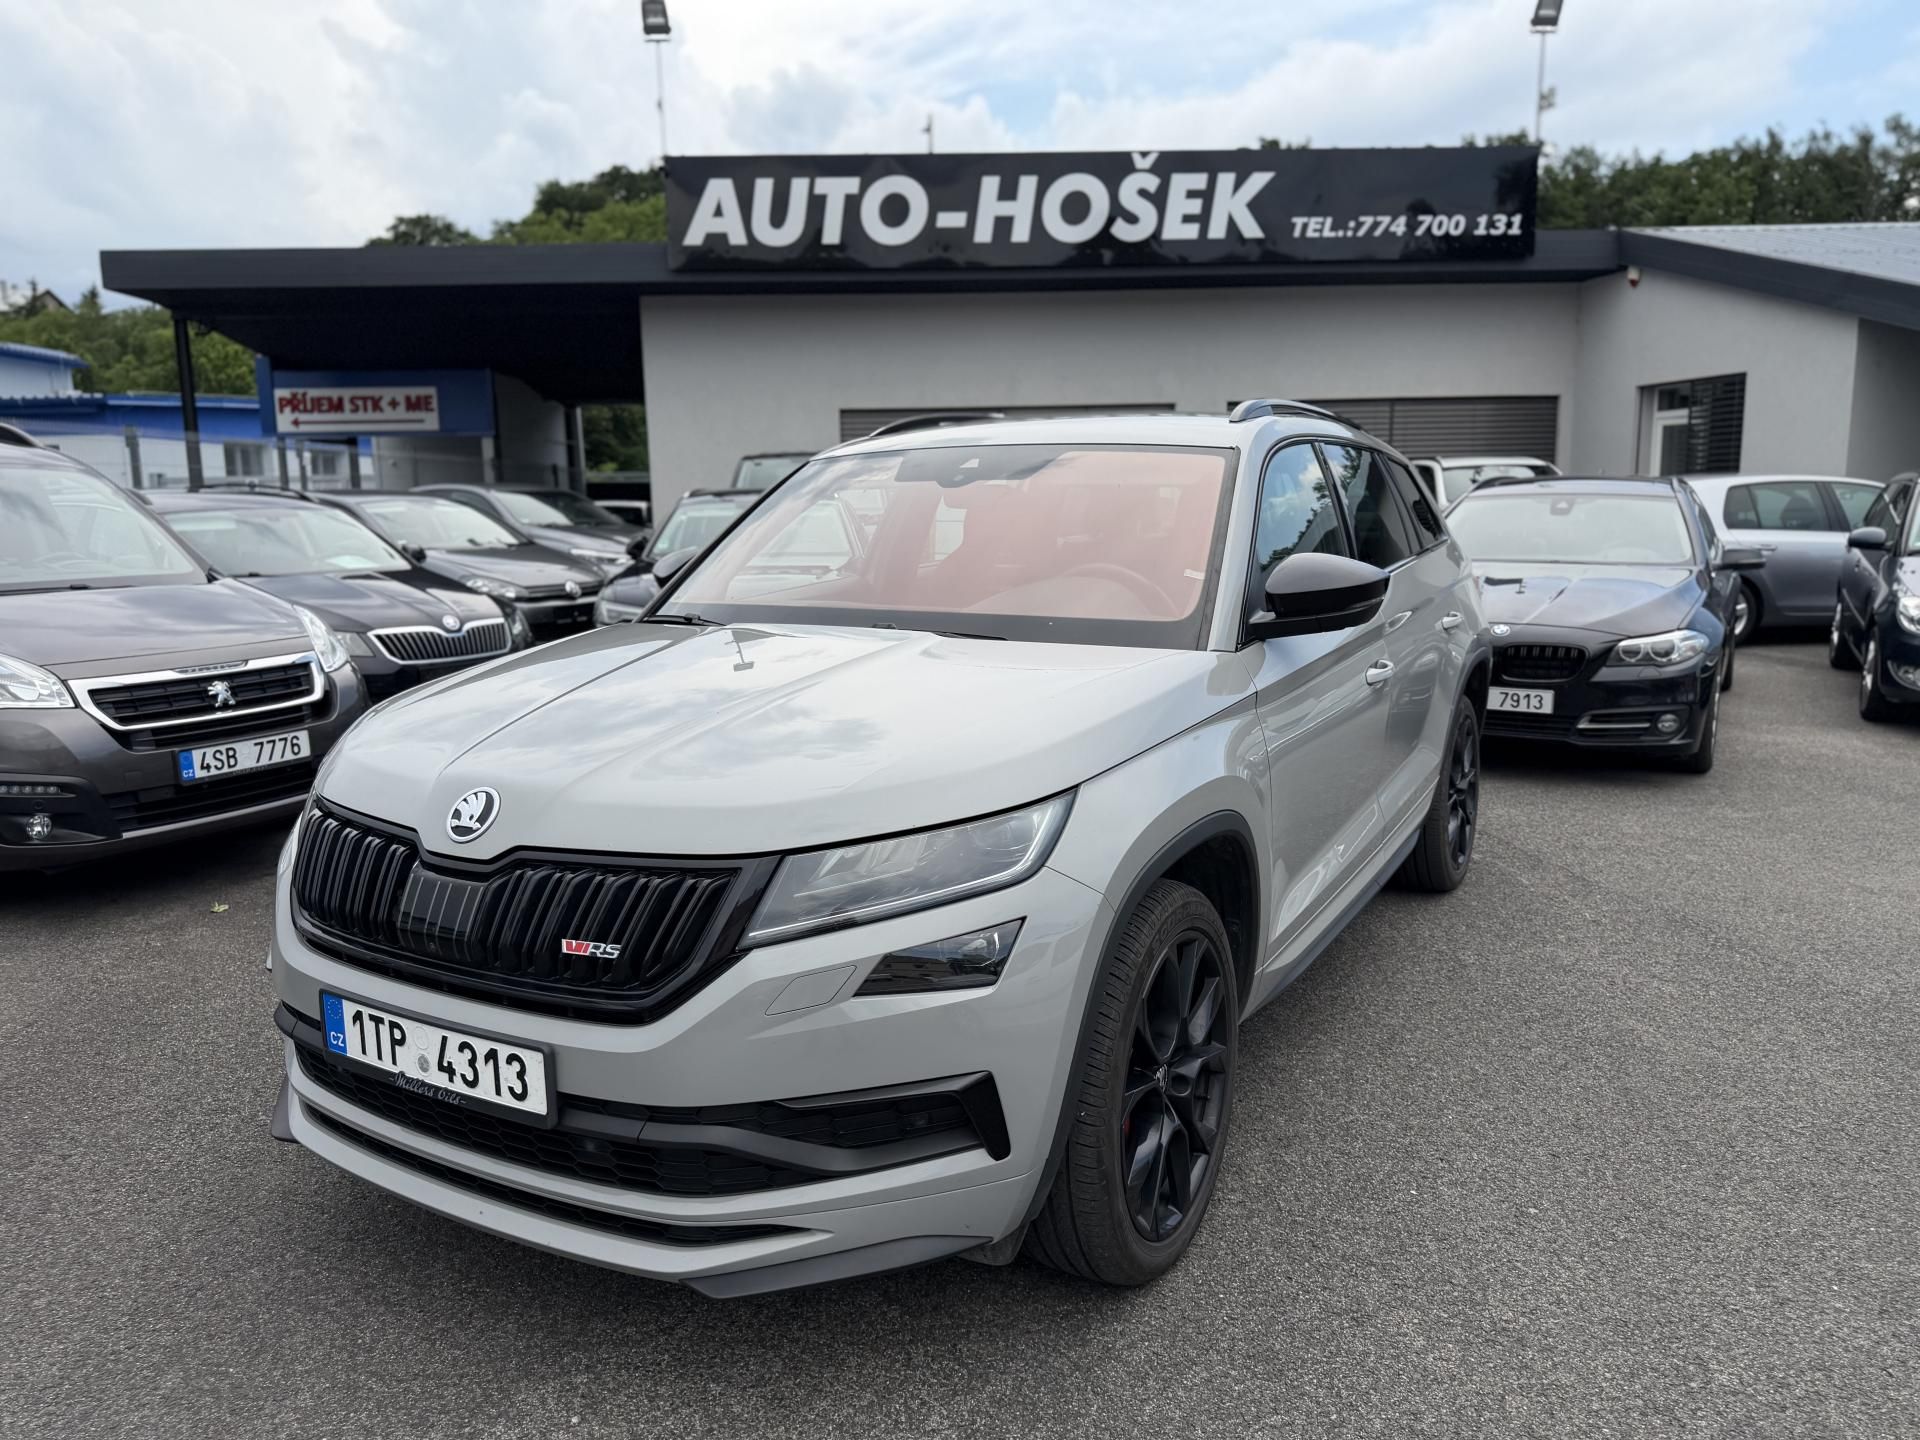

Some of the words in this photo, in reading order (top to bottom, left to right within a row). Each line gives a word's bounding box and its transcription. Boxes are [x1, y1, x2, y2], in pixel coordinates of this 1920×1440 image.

[683, 152, 1277, 247] AUTO-HOŠEK
[1415, 214, 1467, 237] 700
[1473, 213, 1523, 236] 131
[278, 391, 344, 415] PŘÍJEM
[350, 396, 385, 413] STK
[404, 395, 435, 412] ME
[1499, 691, 1544, 710] 7913
[183, 769, 194, 778] CZ
[200, 747, 238, 773] 4SB
[253, 735, 301, 764] 7776
[330, 1031, 345, 1047] CZ
[352, 1009, 407, 1066] 1TP
[438, 1034, 529, 1102] 4313
